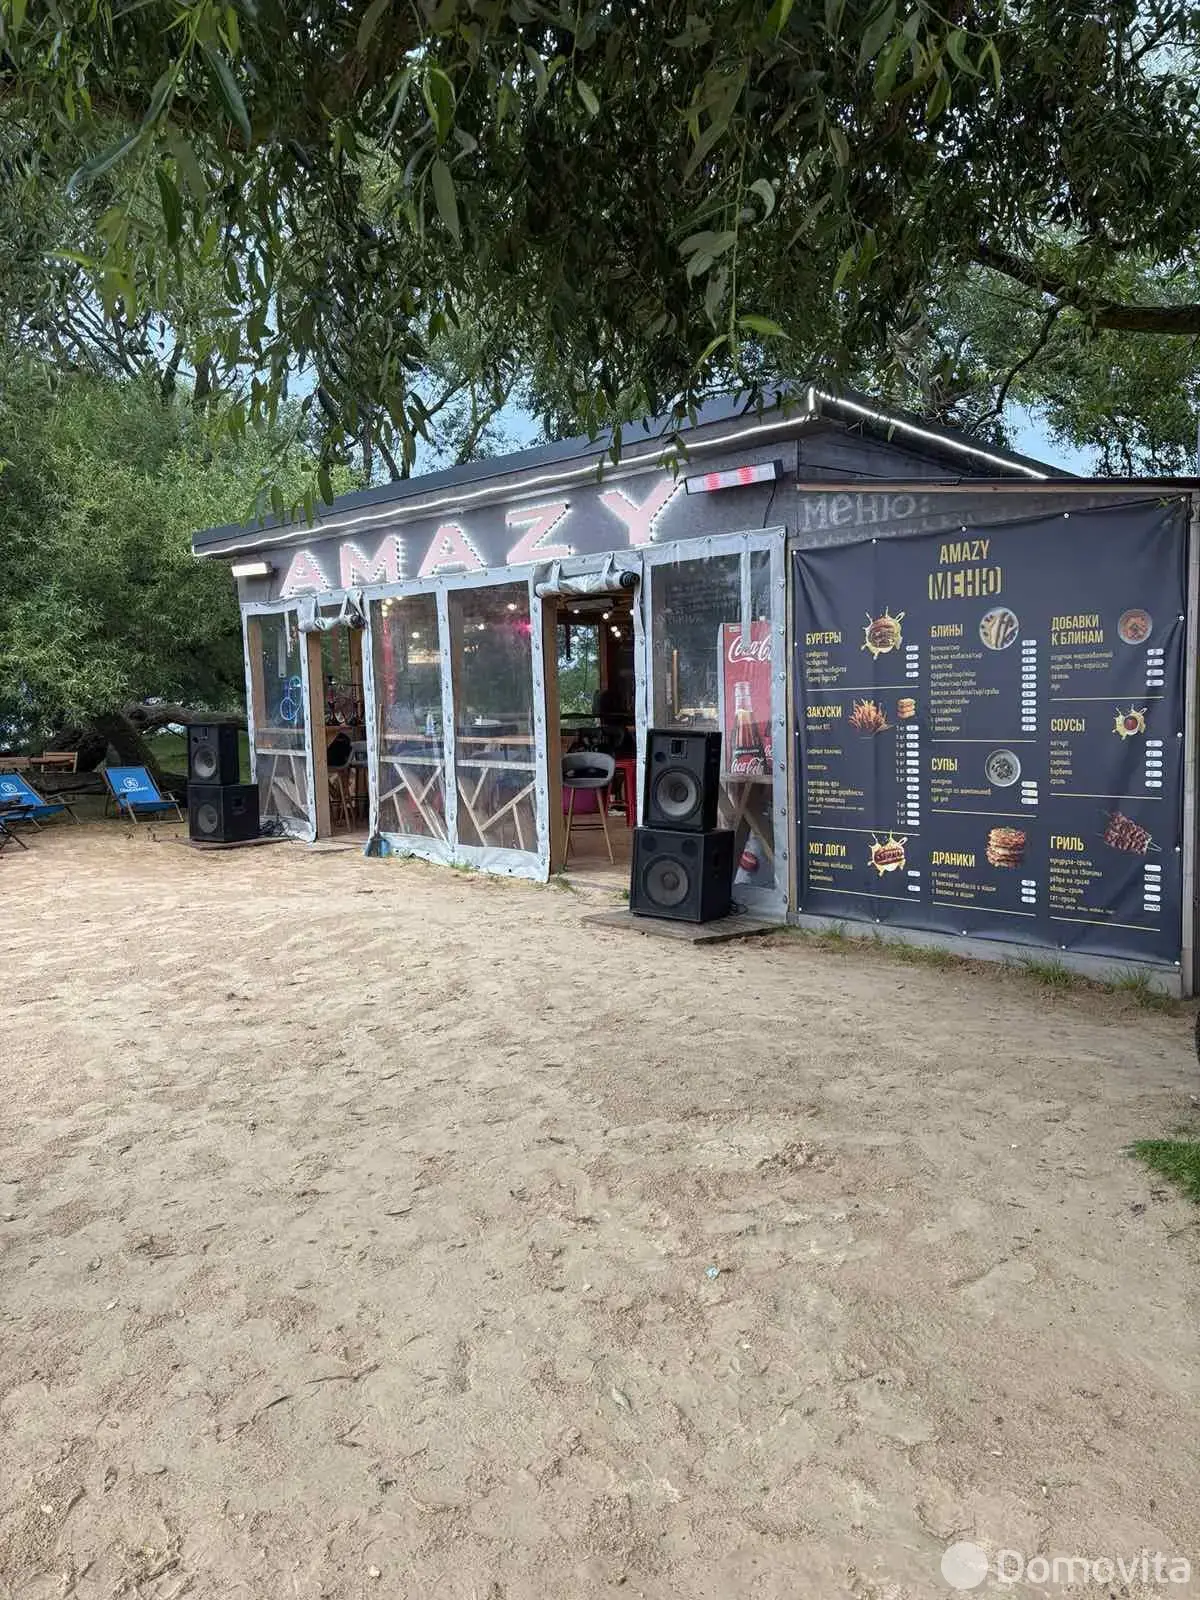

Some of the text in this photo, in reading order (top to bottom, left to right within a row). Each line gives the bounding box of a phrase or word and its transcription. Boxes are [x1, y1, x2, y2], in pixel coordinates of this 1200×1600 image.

[279, 480, 685, 597] AMAZY
[939, 539, 990, 564] AMAZY
[929, 566, 1002, 601] МЕНЮ
[930, 623, 963, 638] БЛИНЫ
[1051, 614, 1099, 631] ДОБАВКИ
[806, 631, 842, 645] БУРГЕРЫ
[1051, 630, 1104, 646] К БЛИНАМ
[807, 706, 842, 718] ЗАКУСКИ
[1050, 718, 1085, 733] СОУСЫ
[931, 757, 958, 771] СУПЫ
[809, 842, 846, 857] ХОТ ДОГИ
[1050, 835, 1085, 852] ГРИЛЬ
[932, 851, 975, 868] ДРАНИКИ
